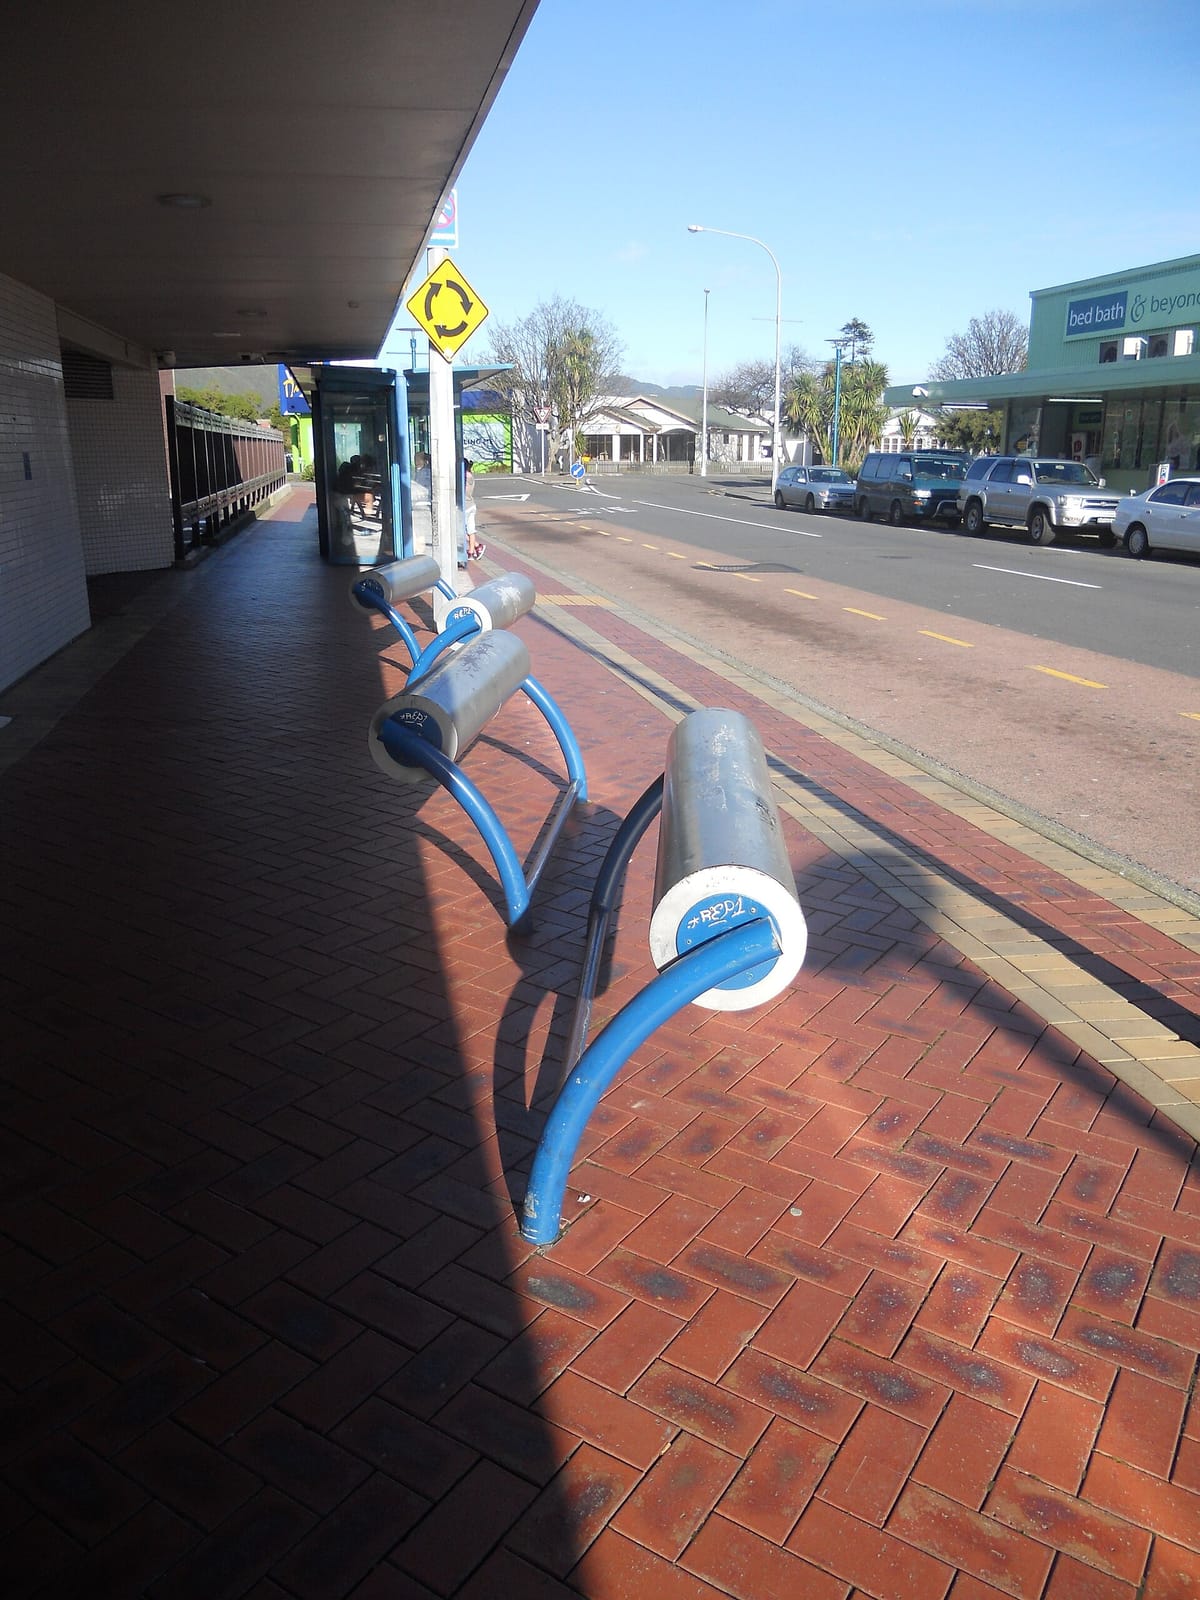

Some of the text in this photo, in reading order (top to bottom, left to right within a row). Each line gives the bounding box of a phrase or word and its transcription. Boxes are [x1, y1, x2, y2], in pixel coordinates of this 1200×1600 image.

[1069, 307, 1093, 326] bed
[1095, 302, 1124, 323] bath
[1131, 294, 1147, 323] &
